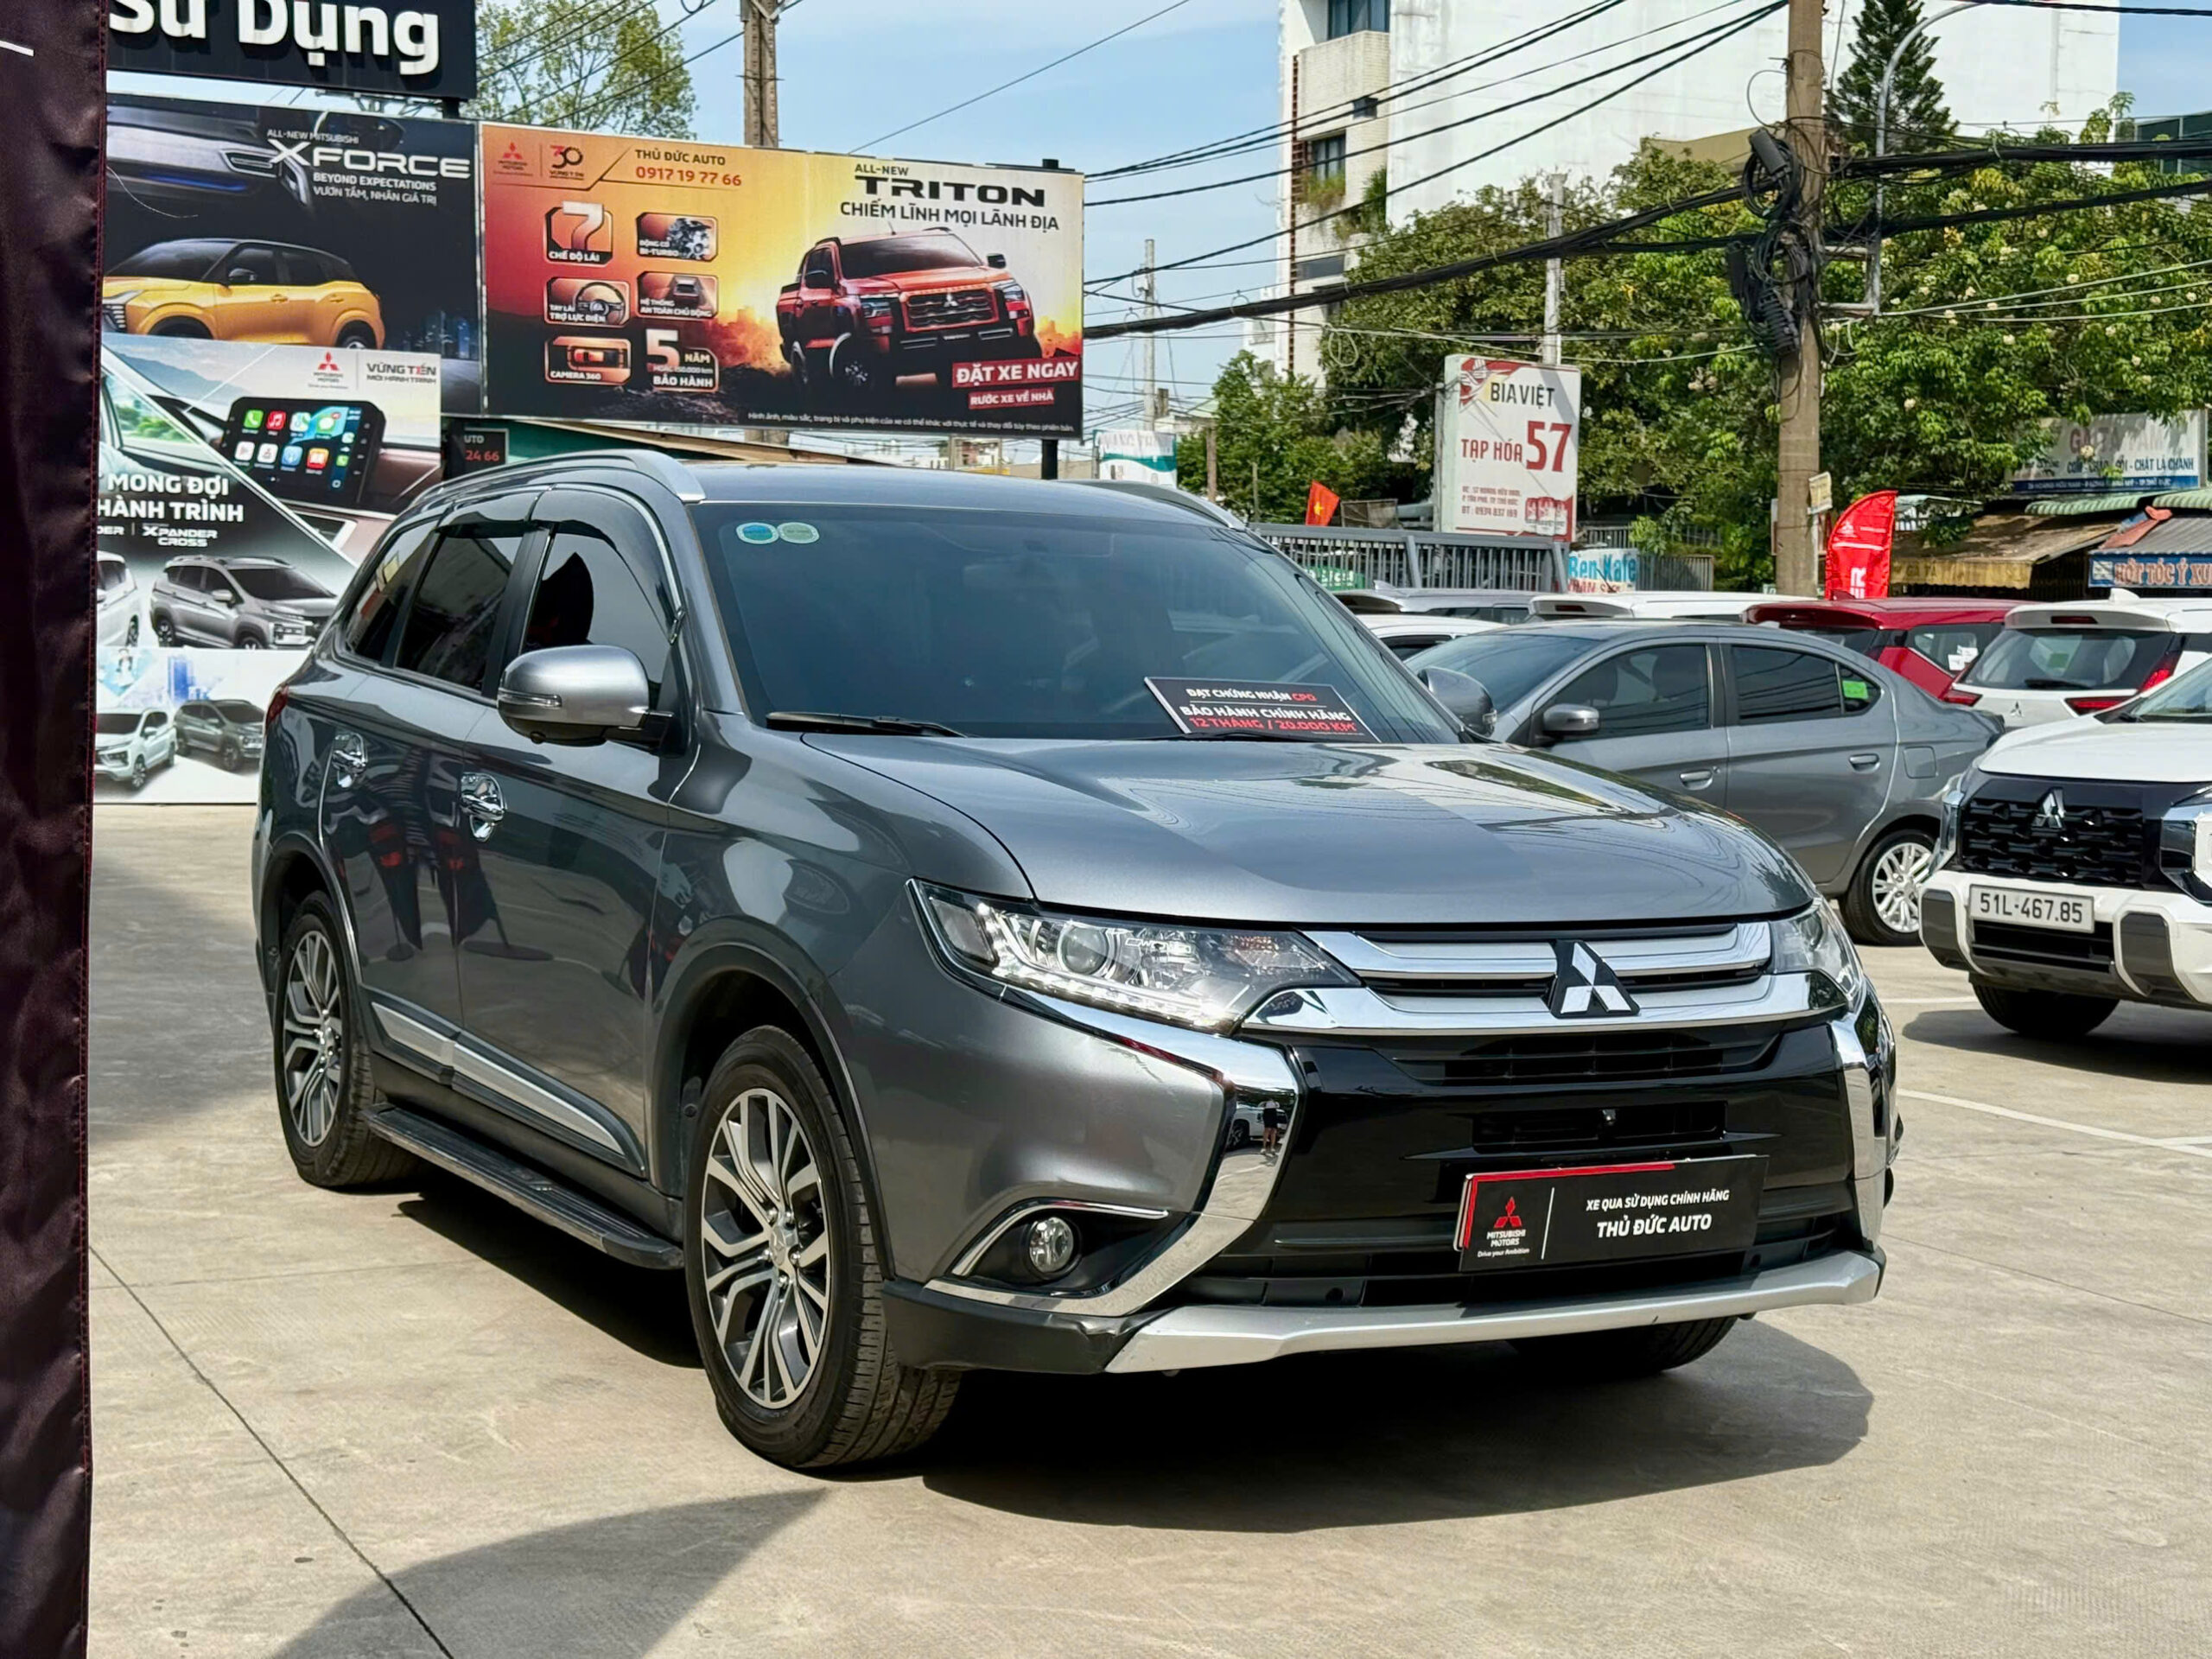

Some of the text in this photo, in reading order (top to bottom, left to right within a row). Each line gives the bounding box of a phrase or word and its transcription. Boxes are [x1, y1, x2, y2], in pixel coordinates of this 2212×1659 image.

[238, 0, 439, 75] Dụng
[267, 130, 359, 144] ALL-NEW MITSUBISHI
[267, 138, 471, 179] XFORCE
[635, 148, 726, 166] THỦ ĐỨC AUTO
[636, 166, 742, 186] 0917 19 77 66
[855, 163, 909, 177] ALL-NEW
[313, 173, 436, 191] BEYOND EXPECTATIONS
[855, 175, 1046, 207] TRITON
[841, 198, 1060, 233] CHIẾM LĨNH MỌI LÃNH ĐỊA
[563, 200, 603, 250] 7
[645, 328, 680, 373] 5
[684, 352, 710, 363] NĂM
[550, 371, 586, 379] CAMERA
[652, 373, 714, 387] BẢO HÀNH
[957, 361, 1079, 386] ĐẶT XE NGAY
[969, 390, 998, 406] RƯỚC
[1000, 393, 1015, 404] XE
[1030, 389, 1054, 404] NHÀ
[1491, 383, 1554, 410] BIA VIỆT
[464, 435, 485, 443] UTO
[1461, 420, 1572, 473] TẠP HÓA 57
[465, 450, 499, 461] 24 66
[107, 474, 229, 499] MONG ĐỢI
[98, 494, 244, 522] HÀNH TRÌNH
[142, 525, 218, 539] XPANDER
[157, 537, 208, 547] CROSS
[2145, 557, 2176, 585] TÓC
[2176, 557, 2189, 585] Ý
[1185, 688, 1212, 700] ĐẠT
[1212, 688, 1256, 700] CHỨNG
[1258, 690, 1292, 702] NHẬN
[1179, 703, 1352, 721] BẢO HÀNH CHÍNH HÃNG
[1189, 717, 1210, 728] 12
[1210, 716, 1264, 729] THÁNG
[1267, 721, 1274, 730] /
[1276, 721, 1331, 731] 20.000
[1980, 893, 2083, 924] 51L-467.85
[1586, 1188, 1730, 1211] XE QUA SỬ DỤNG CHÍNH HÃNG
[1597, 1211, 1713, 1238] THỦ ĐỨC AUTO
[1486, 1229, 1526, 1240] MITSUBISHI
[1491, 1237, 1520, 1248] MOTORS
